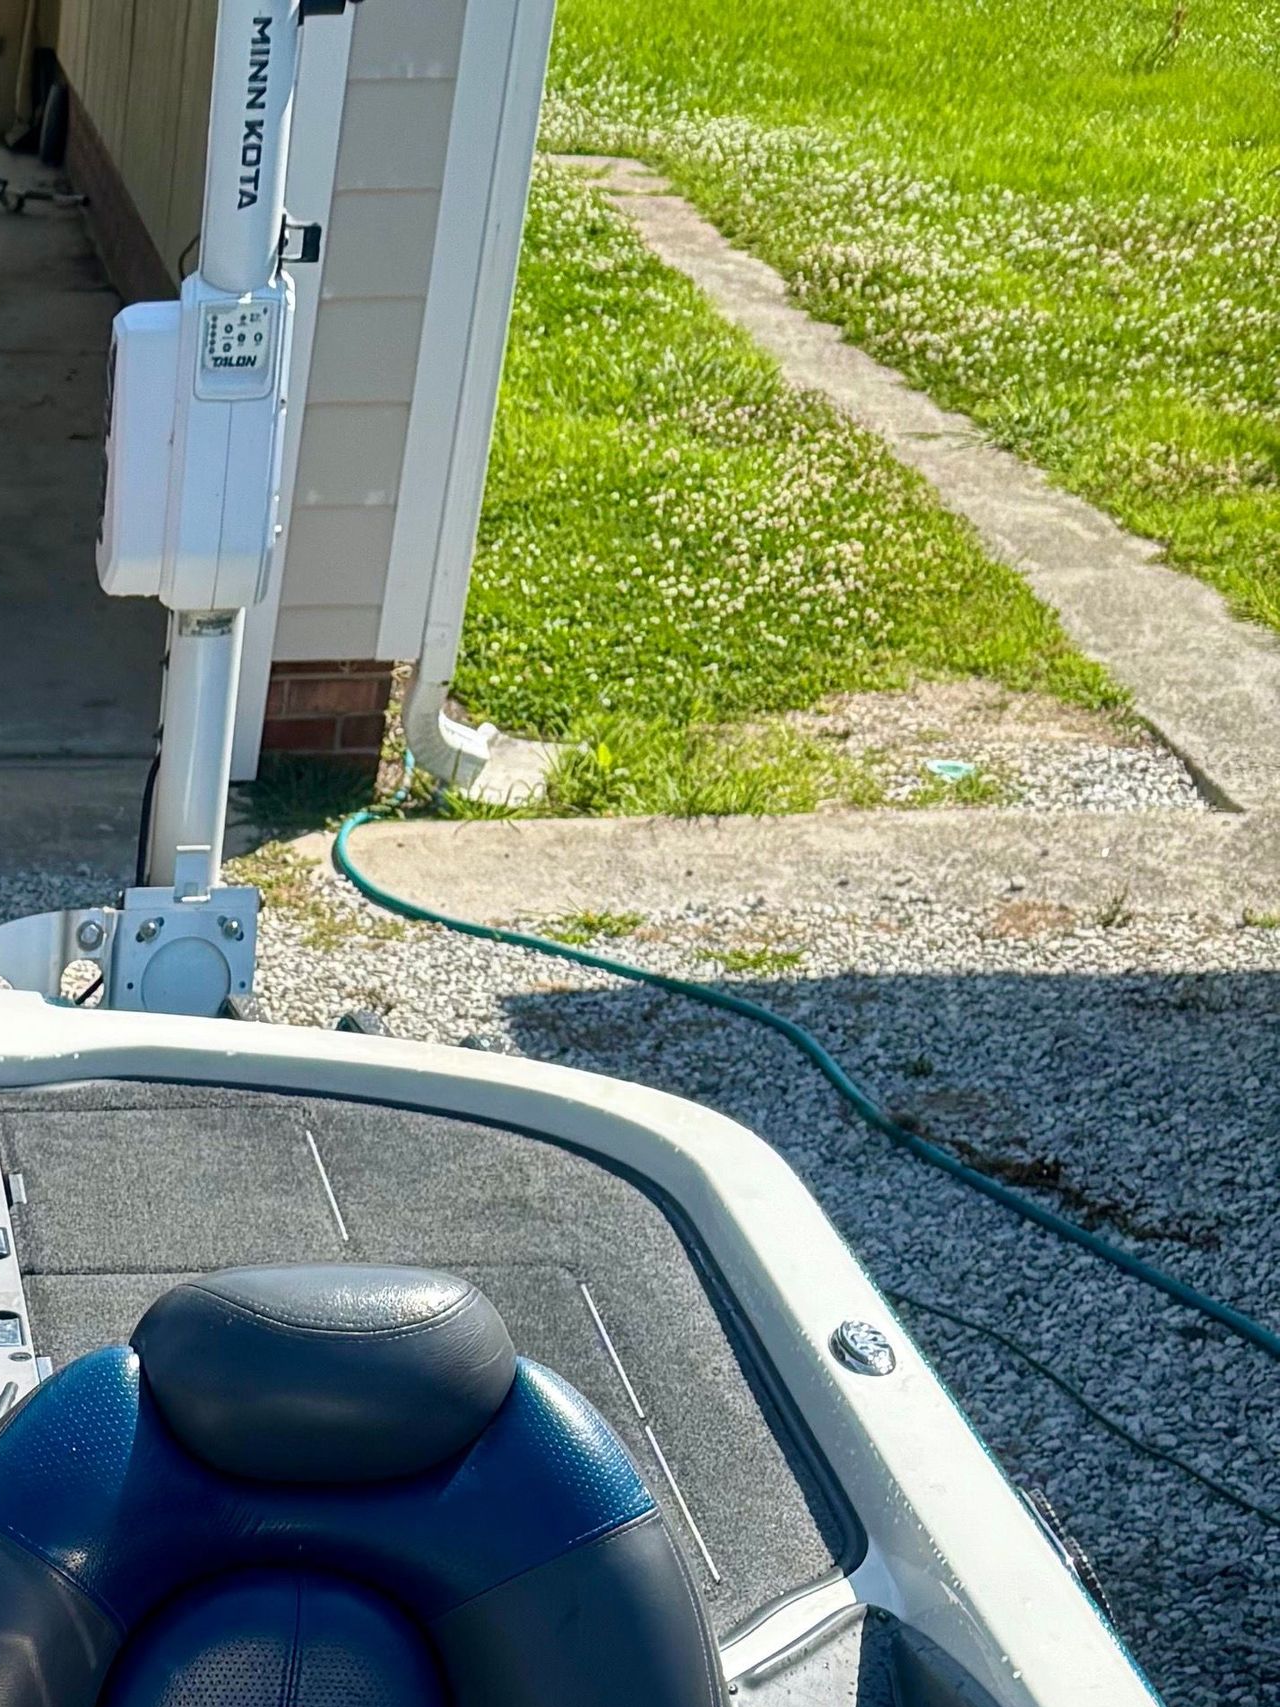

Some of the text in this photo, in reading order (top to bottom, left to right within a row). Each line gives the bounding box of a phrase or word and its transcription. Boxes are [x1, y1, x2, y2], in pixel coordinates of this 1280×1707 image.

[238, 16, 272, 210] MINN KOTA
[212, 355, 257, 367] TALON
